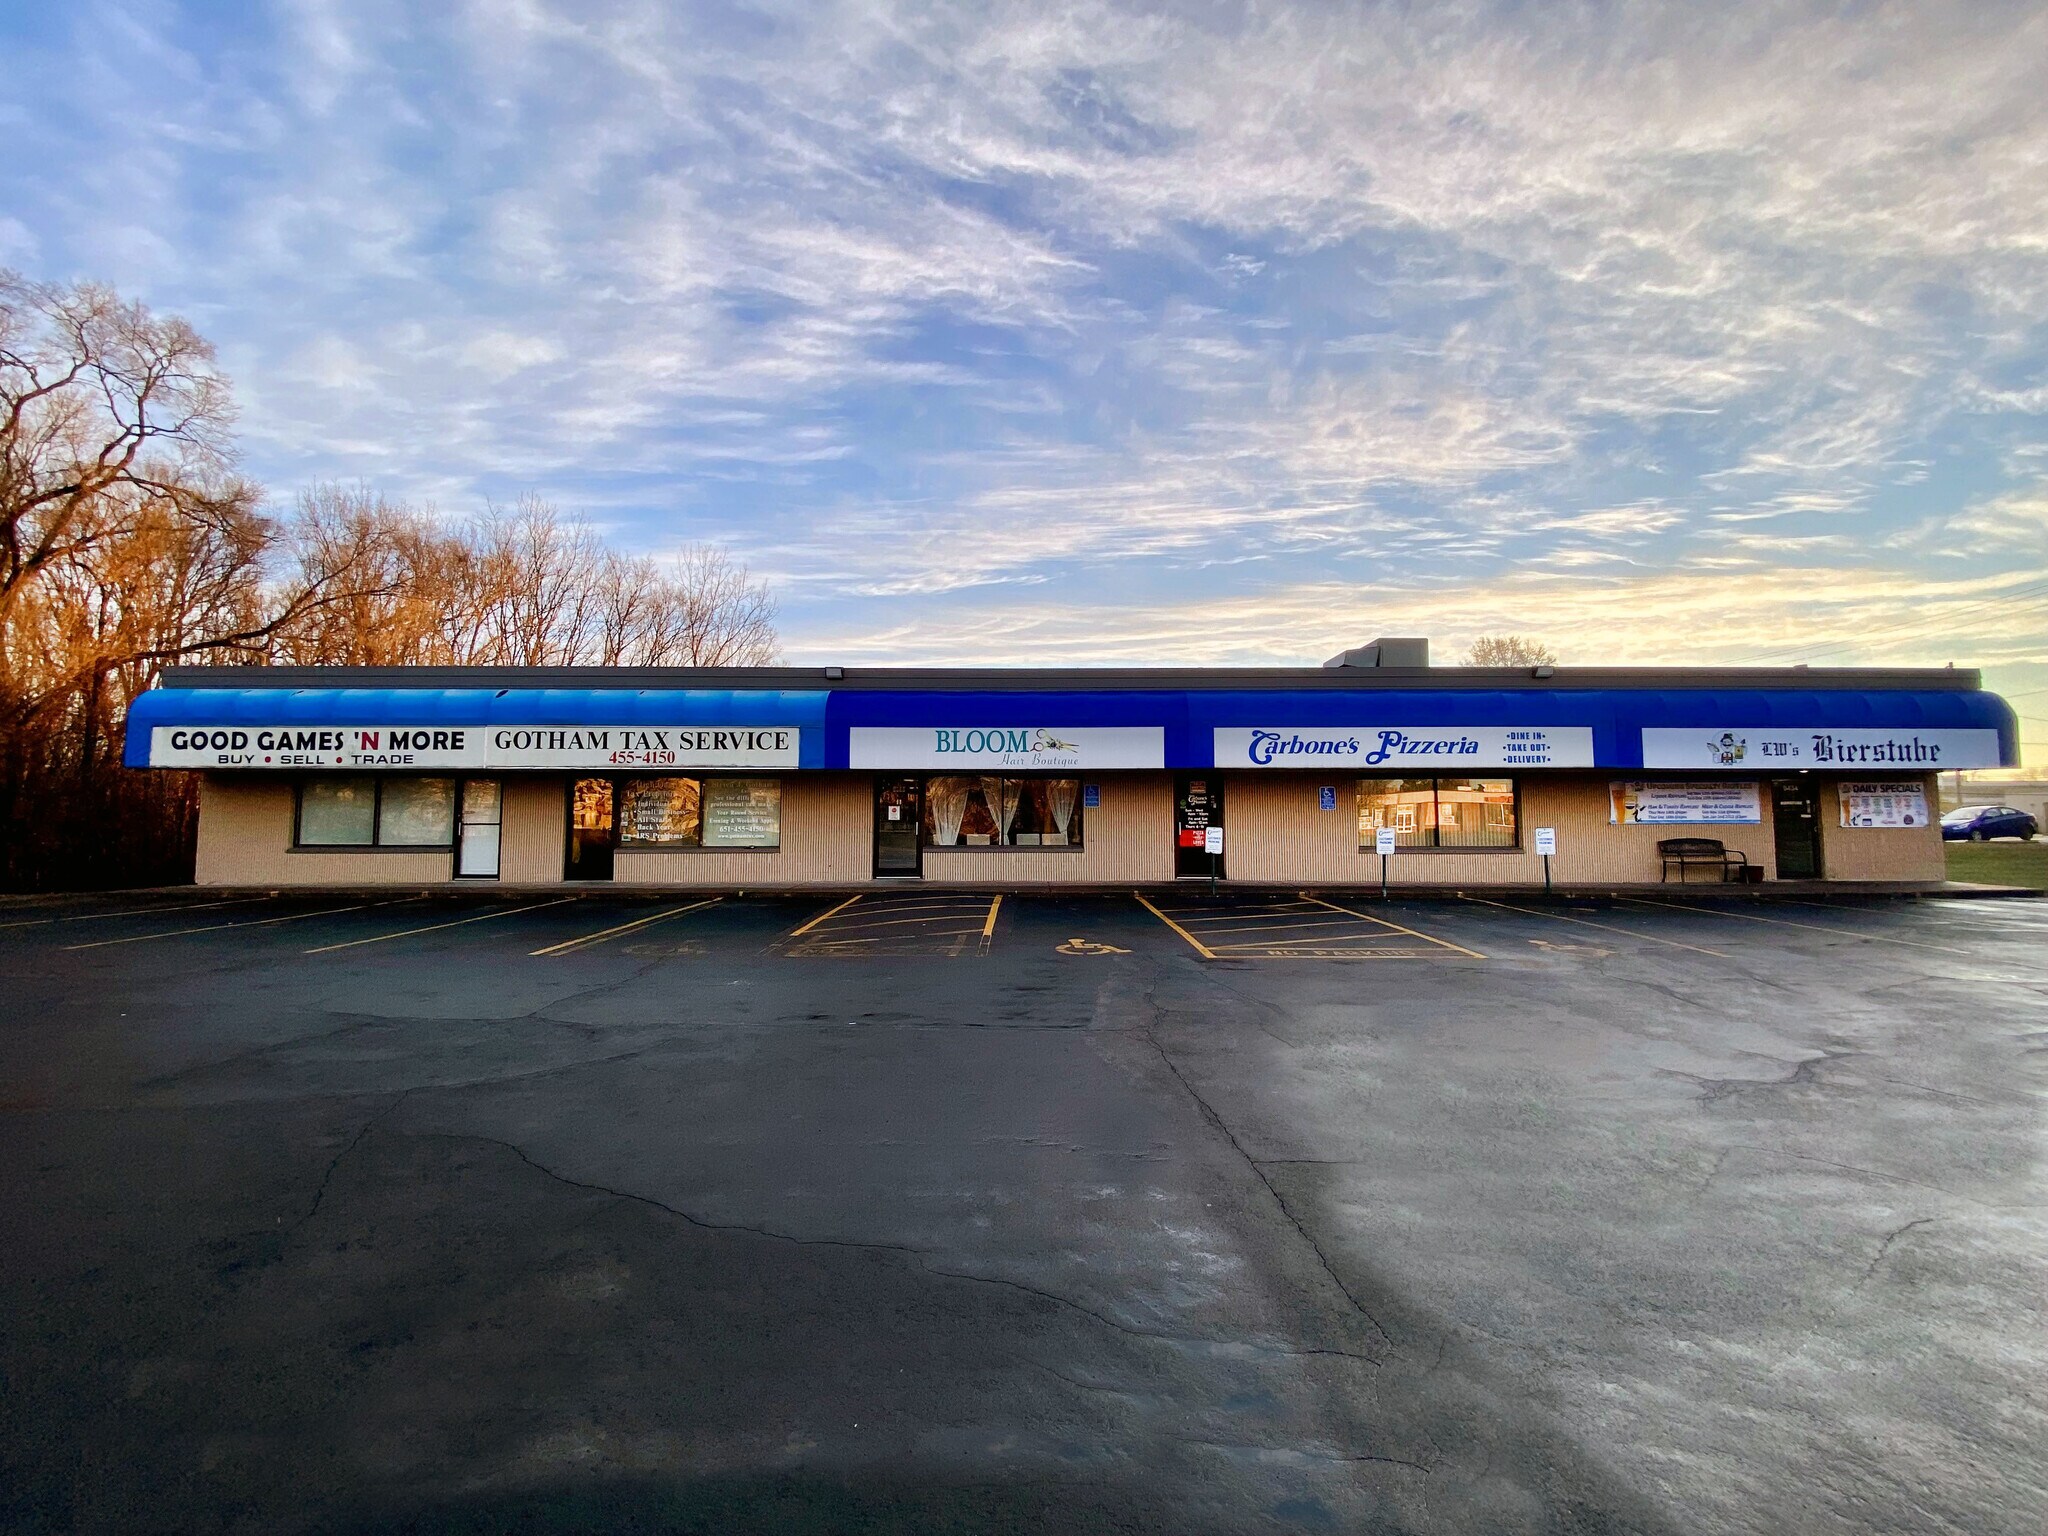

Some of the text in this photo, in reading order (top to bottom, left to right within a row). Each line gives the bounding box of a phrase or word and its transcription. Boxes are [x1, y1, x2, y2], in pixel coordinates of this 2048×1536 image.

[171, 731, 465, 751] GOOD GAMES 'N MORE
[494, 730, 790, 750] GOTHAM TAX SERVICE
[935, 729, 1030, 753] BLOOM
[1510, 732, 1542, 740] DINE IN
[1249, 730, 1479, 765] Carbone's Pizzeria
[1507, 743, 1546, 752] TAKE OUT
[1811, 734, 1941, 763] Bierstube
[218, 755, 414, 765] BUY SELL TRADE
[608, 750, 676, 765] 455-4150
[997, 752, 1079, 767] Hair Boutique
[1507, 755, 1546, 764] DELIVERY
[1852, 784, 1921, 793] DAILY SPECIALS
